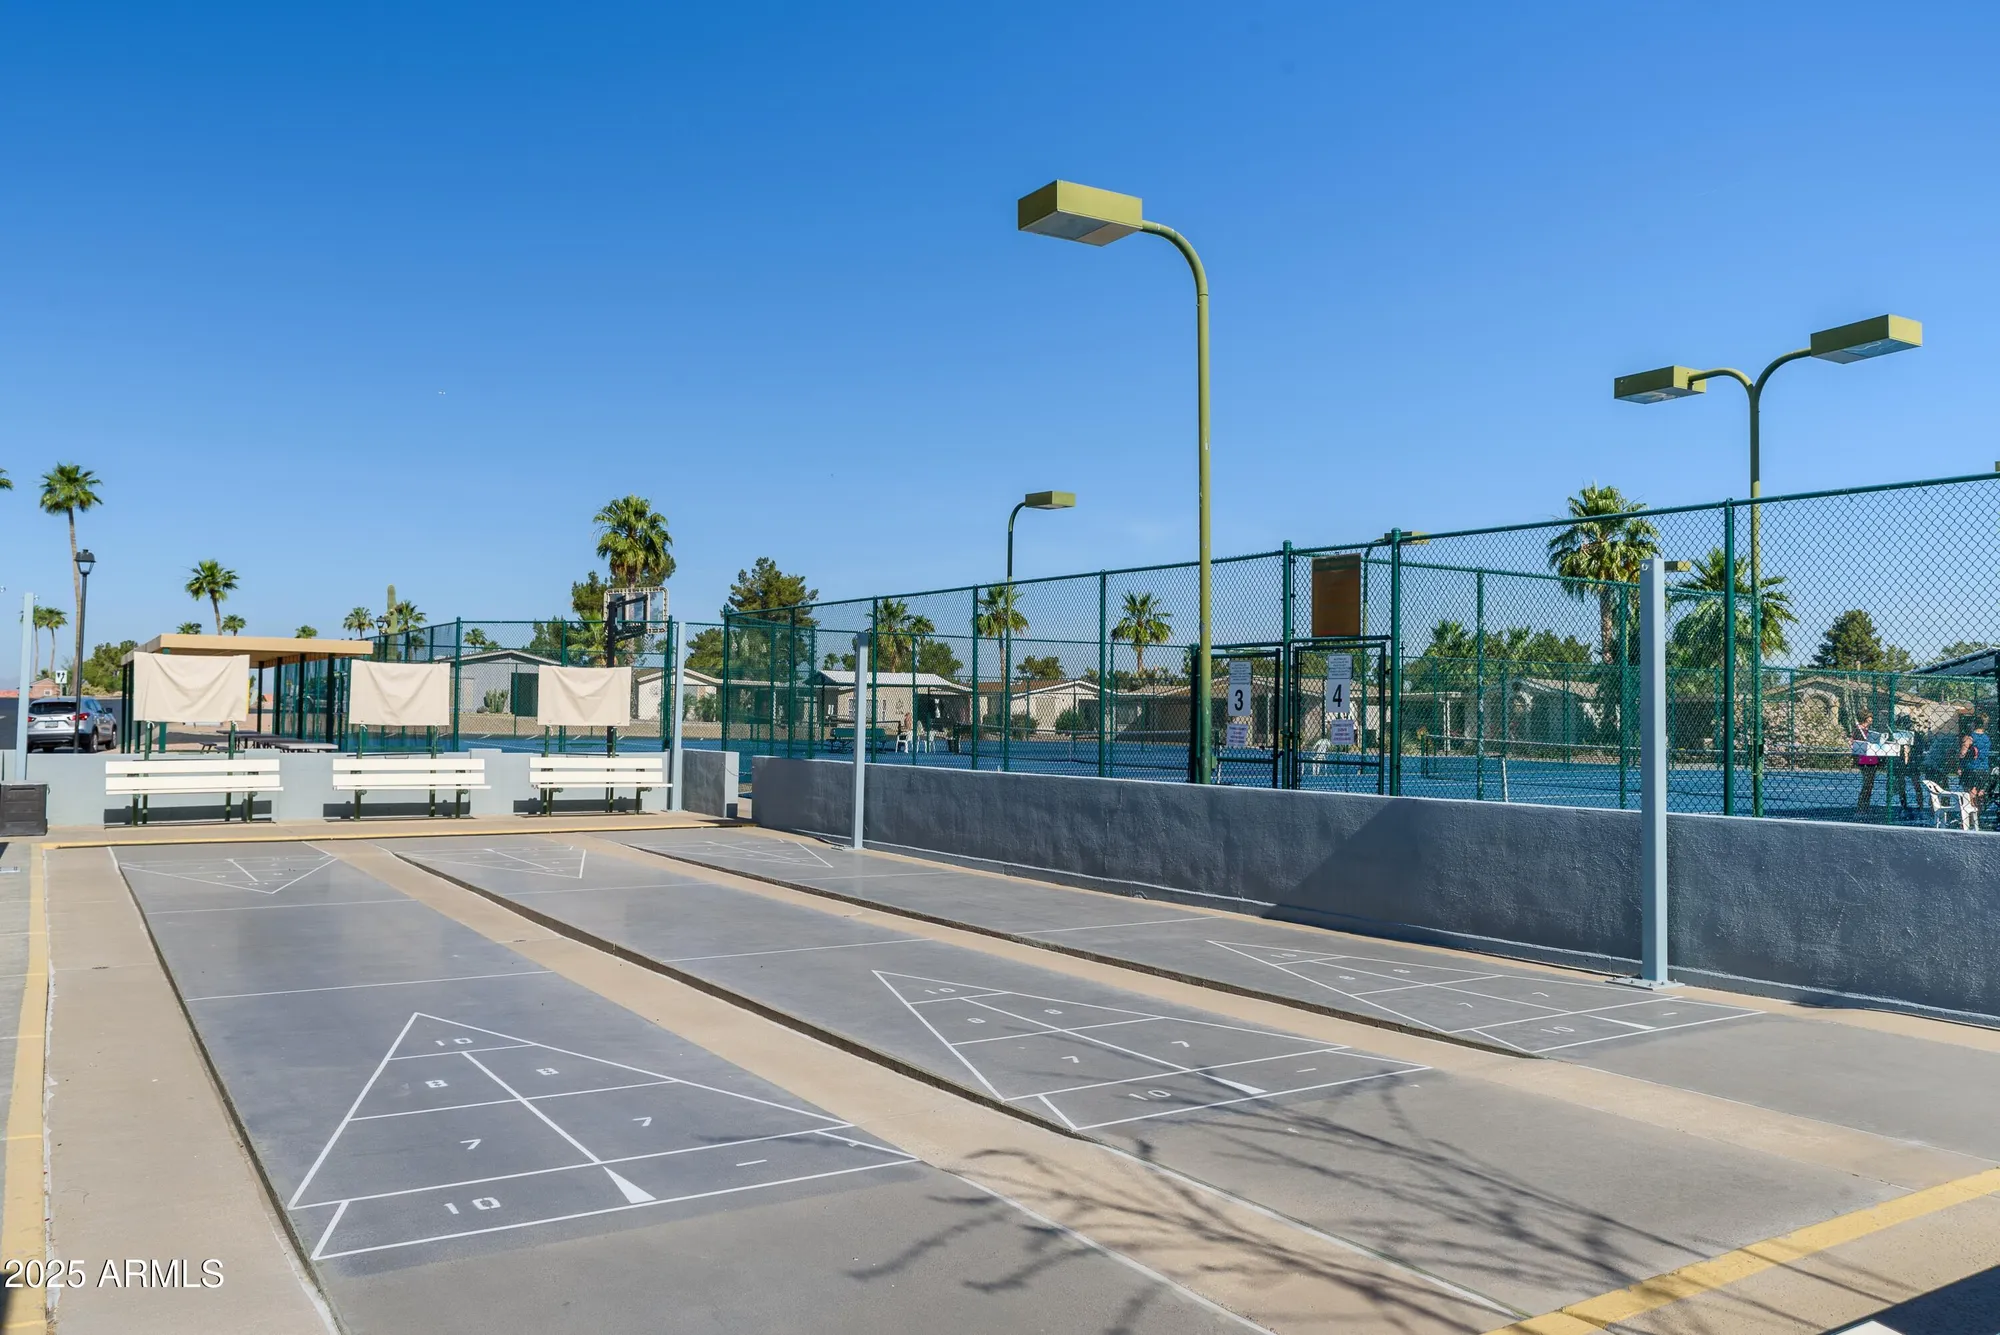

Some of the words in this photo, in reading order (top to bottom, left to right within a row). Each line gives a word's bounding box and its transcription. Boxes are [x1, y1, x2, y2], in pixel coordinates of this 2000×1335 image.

[1234, 689, 1244, 711] 3
[1332, 684, 1343, 708] 4
[924, 987, 956, 995] 10
[1540, 1026, 1575, 1035] 10
[435, 1037, 473, 1046] 10
[1171, 1040, 1190, 1048] 7
[1060, 1055, 1080, 1064] 7
[535, 1067, 559, 1076] 8
[425, 1079, 449, 1088] 8
[1128, 1089, 1172, 1102] 10
[632, 1116, 652, 1127] 7
[460, 1138, 481, 1150] 7
[443, 1197, 501, 1215] 10
